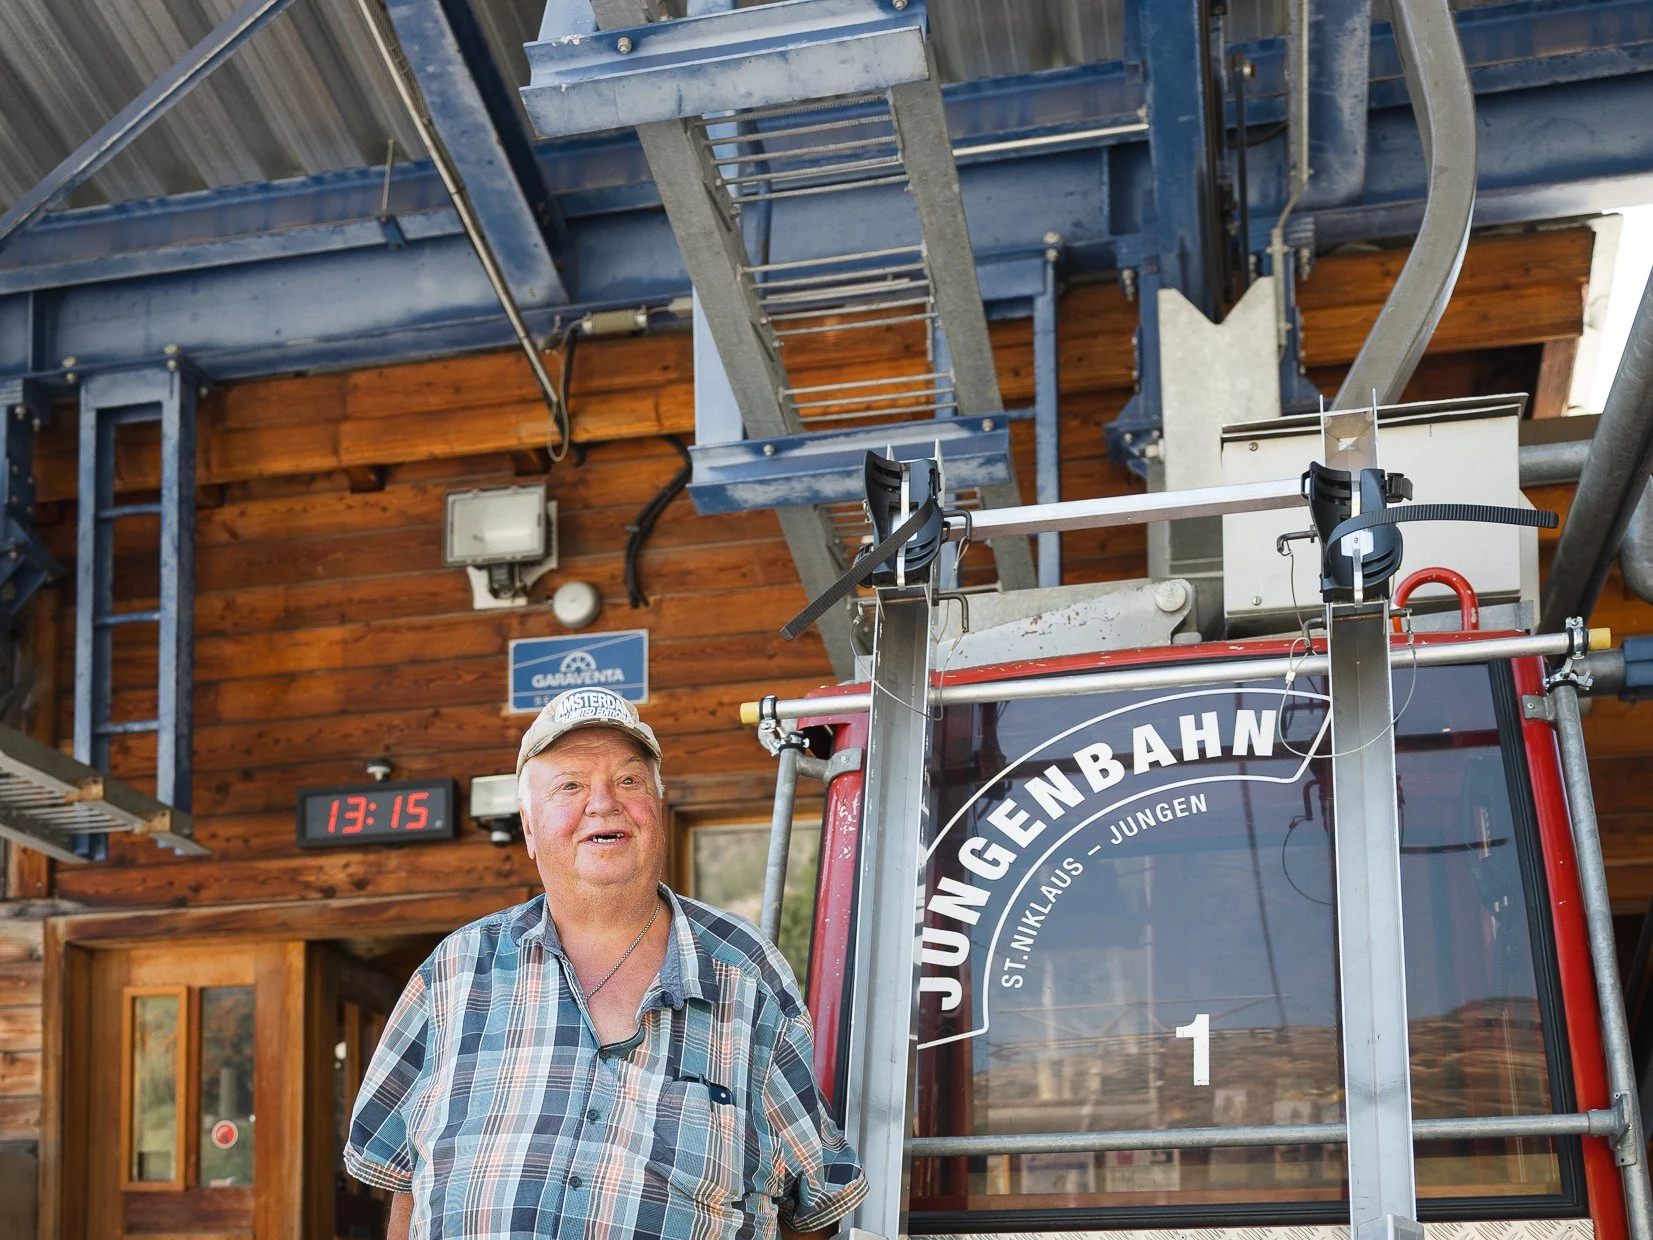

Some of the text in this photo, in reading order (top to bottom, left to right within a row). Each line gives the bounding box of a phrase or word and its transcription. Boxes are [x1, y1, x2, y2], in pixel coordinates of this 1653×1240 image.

[531, 667, 626, 689] GARAVENTA
[327, 791, 430, 834] 13:15
[918, 708, 1277, 1012] JUNGENBAHN
[1000, 857, 1084, 989] ST.NIKLAUS
[1109, 793, 1208, 845] JUNGEN
[1174, 1012, 1211, 1087] 1
